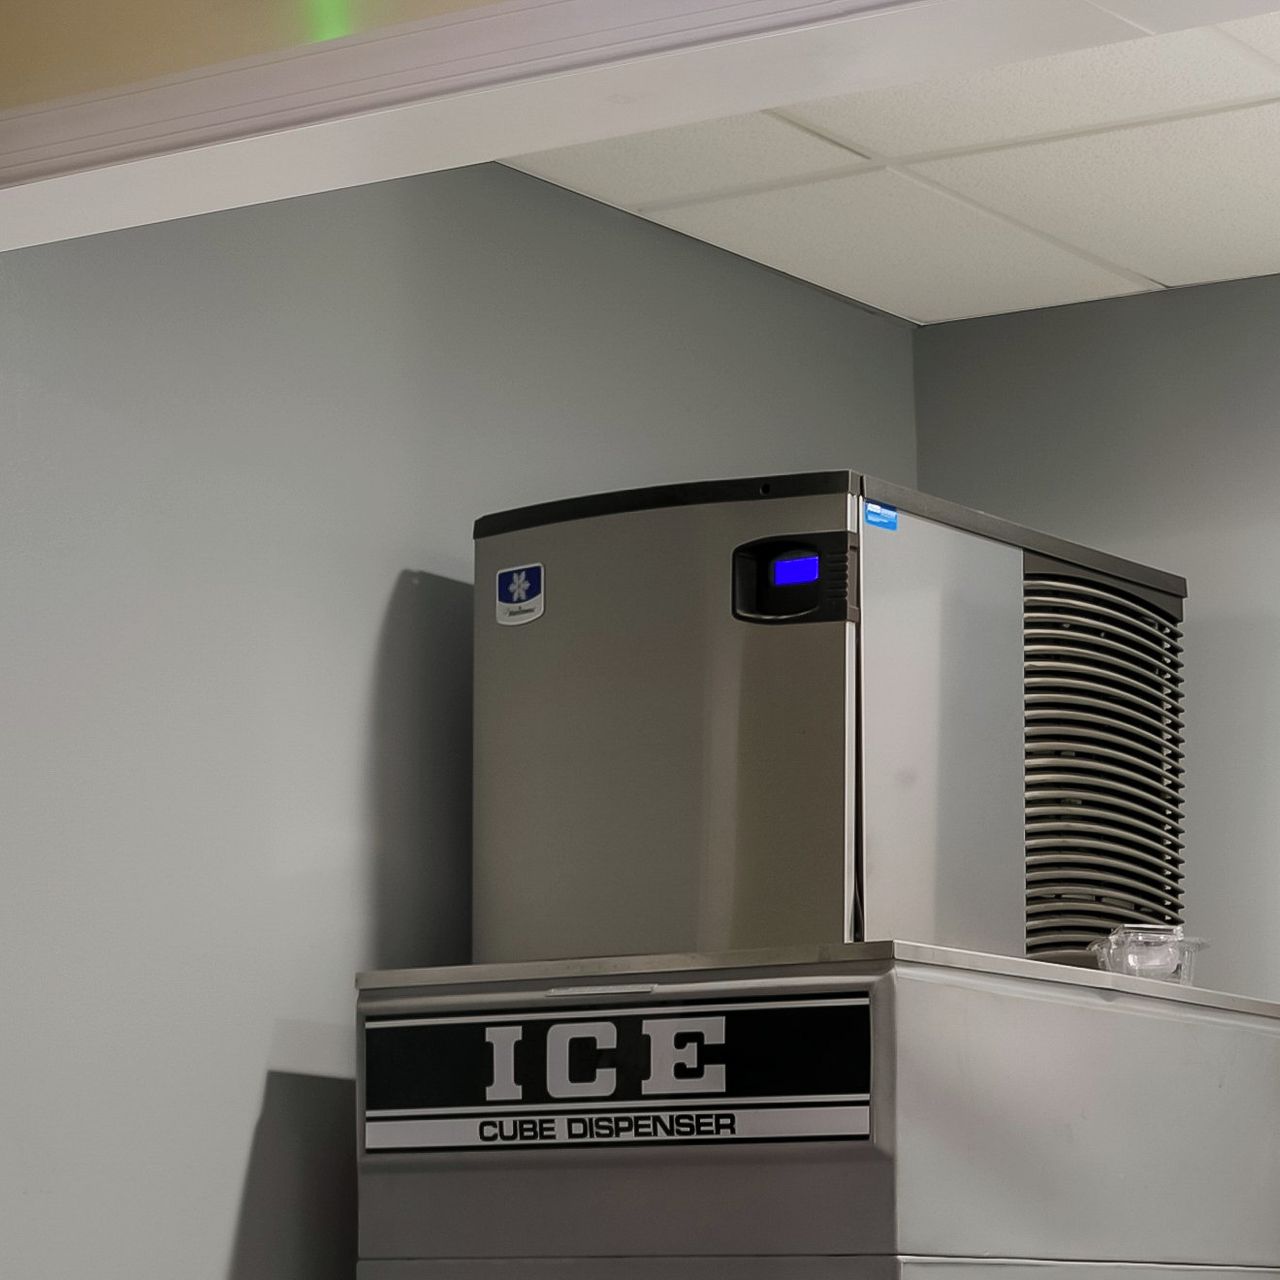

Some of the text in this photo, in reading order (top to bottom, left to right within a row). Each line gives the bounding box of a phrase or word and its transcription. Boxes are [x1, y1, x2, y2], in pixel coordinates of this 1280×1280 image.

[485, 1015, 726, 1101] ICE
[478, 1112, 737, 1143] CUBE DISPENSER
